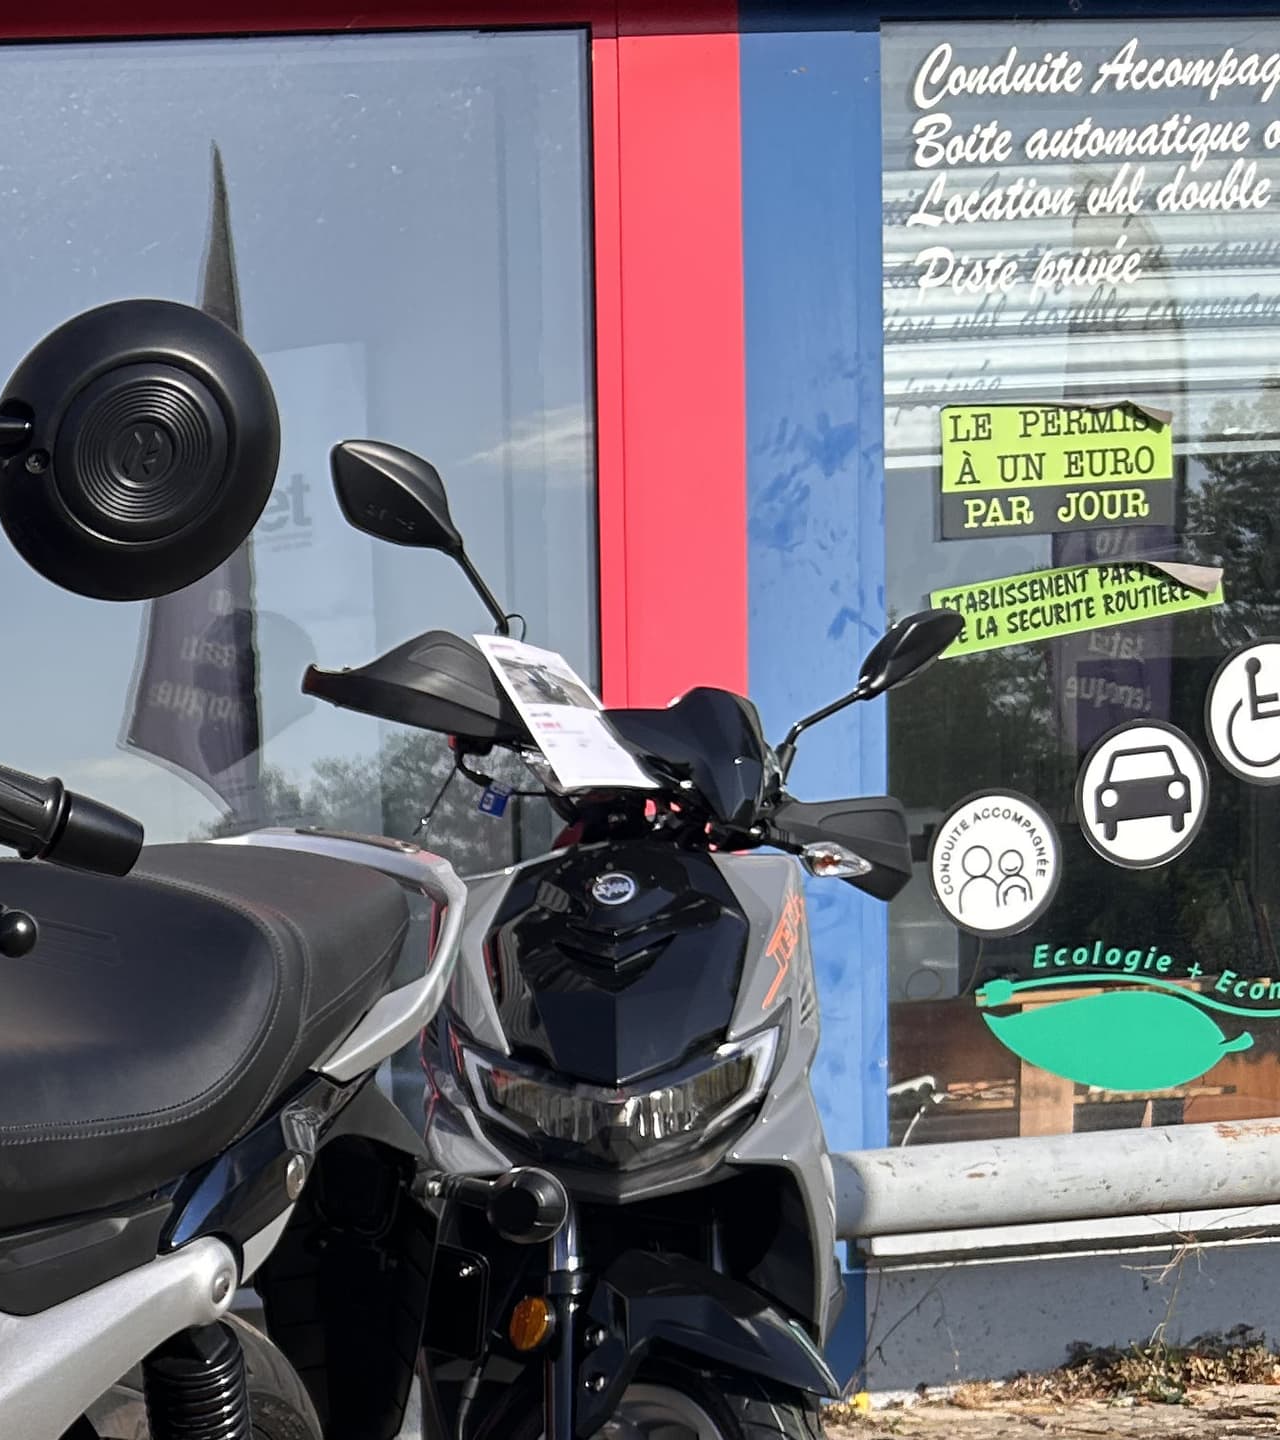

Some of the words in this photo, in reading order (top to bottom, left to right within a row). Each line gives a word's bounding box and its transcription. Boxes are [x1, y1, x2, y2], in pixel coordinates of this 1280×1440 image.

[914, 43, 1083, 109] Conduite
[912, 112, 1013, 168] Boite
[1026, 113, 1250, 171] automatique
[906, 171, 1078, 228] Location
[1088, 162, 1146, 215] vhl
[1156, 157, 1272, 212] double
[913, 246, 1018, 304] Piste
[1029, 234, 1142, 304] privée
[949, 413, 992, 443] LE
[1018, 407, 1150, 438] PERMIS
[955, 450, 981, 485] À
[997, 452, 1046, 483] UN
[1064, 445, 1155, 478] EURO
[964, 495, 1034, 528] PAR
[1057, 488, 1150, 523] JOUR
[976, 616, 998, 641] LA
[1007, 597, 1096, 634] SECURITE
[1102, 581, 1191, 616] ROUTIERE
[940, 819, 970, 896] CONDUITE
[973, 806, 1050, 878] ACCOMPAGNÉE
[1033, 941, 1173, 973] Ecologie
